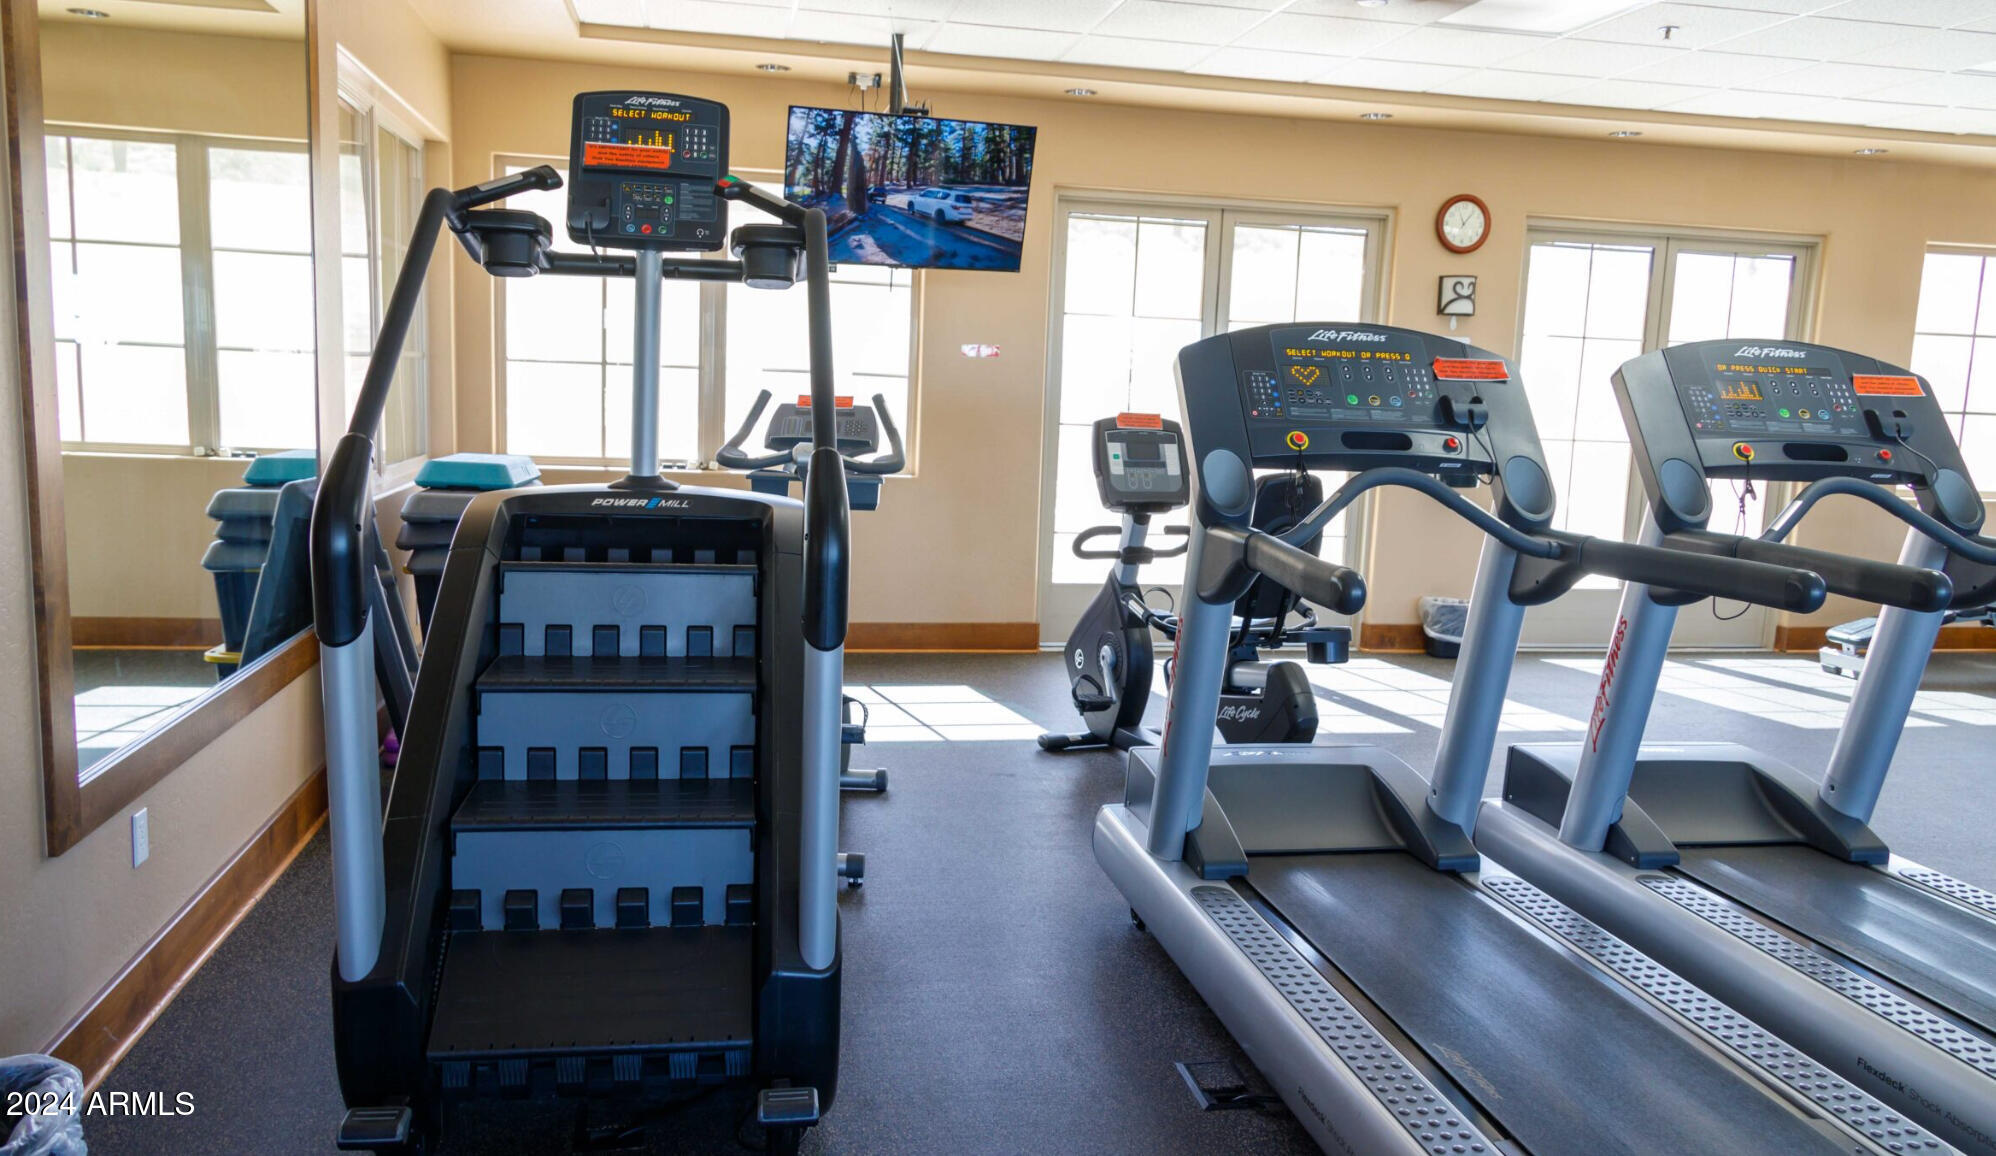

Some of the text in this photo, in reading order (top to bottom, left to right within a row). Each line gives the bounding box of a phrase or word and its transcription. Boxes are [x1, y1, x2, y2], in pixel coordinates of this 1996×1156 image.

[612, 108, 691, 121] SELECT WORKOUT
[1286, 348, 1316, 357] SELECT
[1321, 349, 1356, 358] WORKOUT
[1361, 351, 1371, 359] OR
[1375, 352, 1401, 360] PRESS
[591, 498, 689, 508] POWER MILL
[1856, 1056, 1905, 1094] Flexdeck
[1909, 1087, 1942, 1116] Shock
